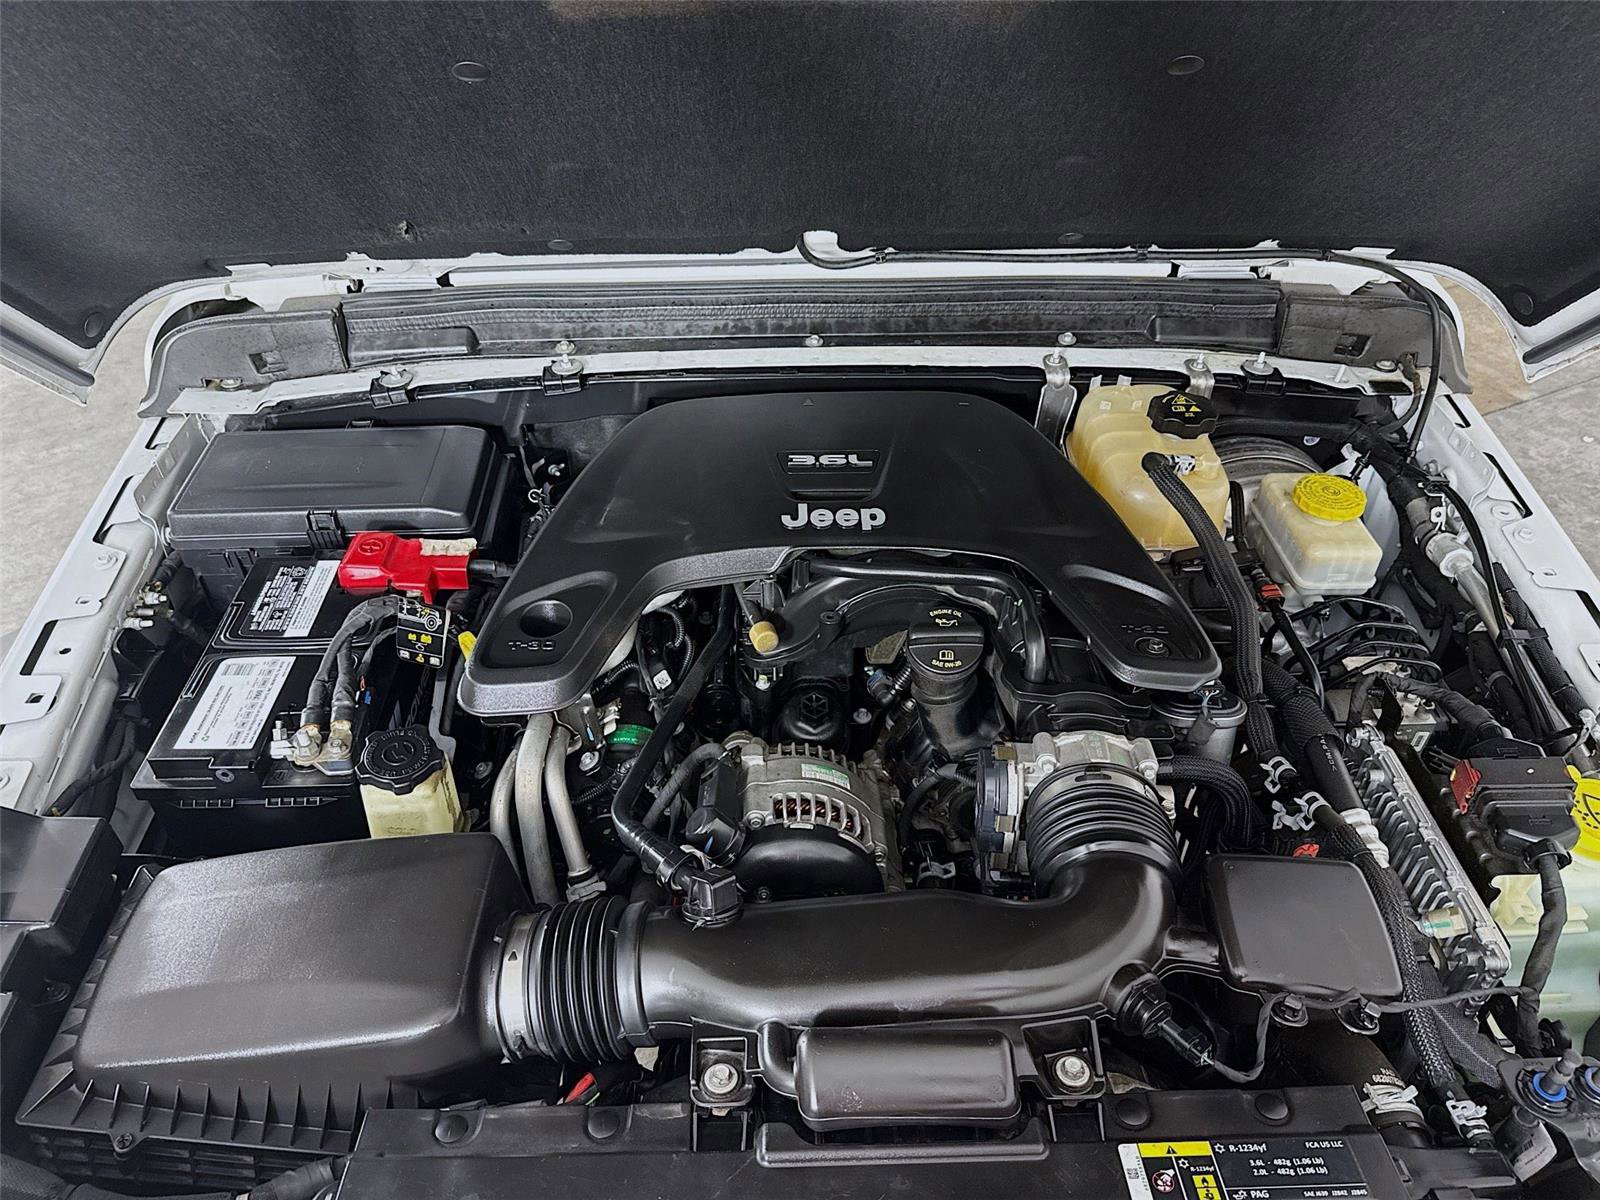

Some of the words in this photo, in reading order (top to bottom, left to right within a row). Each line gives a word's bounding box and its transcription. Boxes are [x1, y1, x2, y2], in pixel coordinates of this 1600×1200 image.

[787, 453, 873, 468] 3.6L
[780, 503, 886, 532] Jeep
[929, 608, 952, 617] ENGINE
[952, 610, 962, 618] OIL
[931, 659, 944, 668] SAE
[944, 660, 962, 668] 0W-20
[1228, 1143, 1267, 1153] R-1234yf
[1305, 1141, 1320, 1149] FCA
[1330, 1140, 1344, 1148] LLC
[1249, 1159, 1265, 1167] 3.6L
[1273, 1159, 1291, 1167] 482g
[1293, 1157, 1312, 1166] (1.06
[1312, 1157, 1324, 1165] Lb)
[1277, 1168, 1295, 1176] 482g
[1297, 1167, 1316, 1176] (1.06
[1316, 1166, 1328, 1175] Lb)
[1250, 1190, 1270, 1199] PAG
